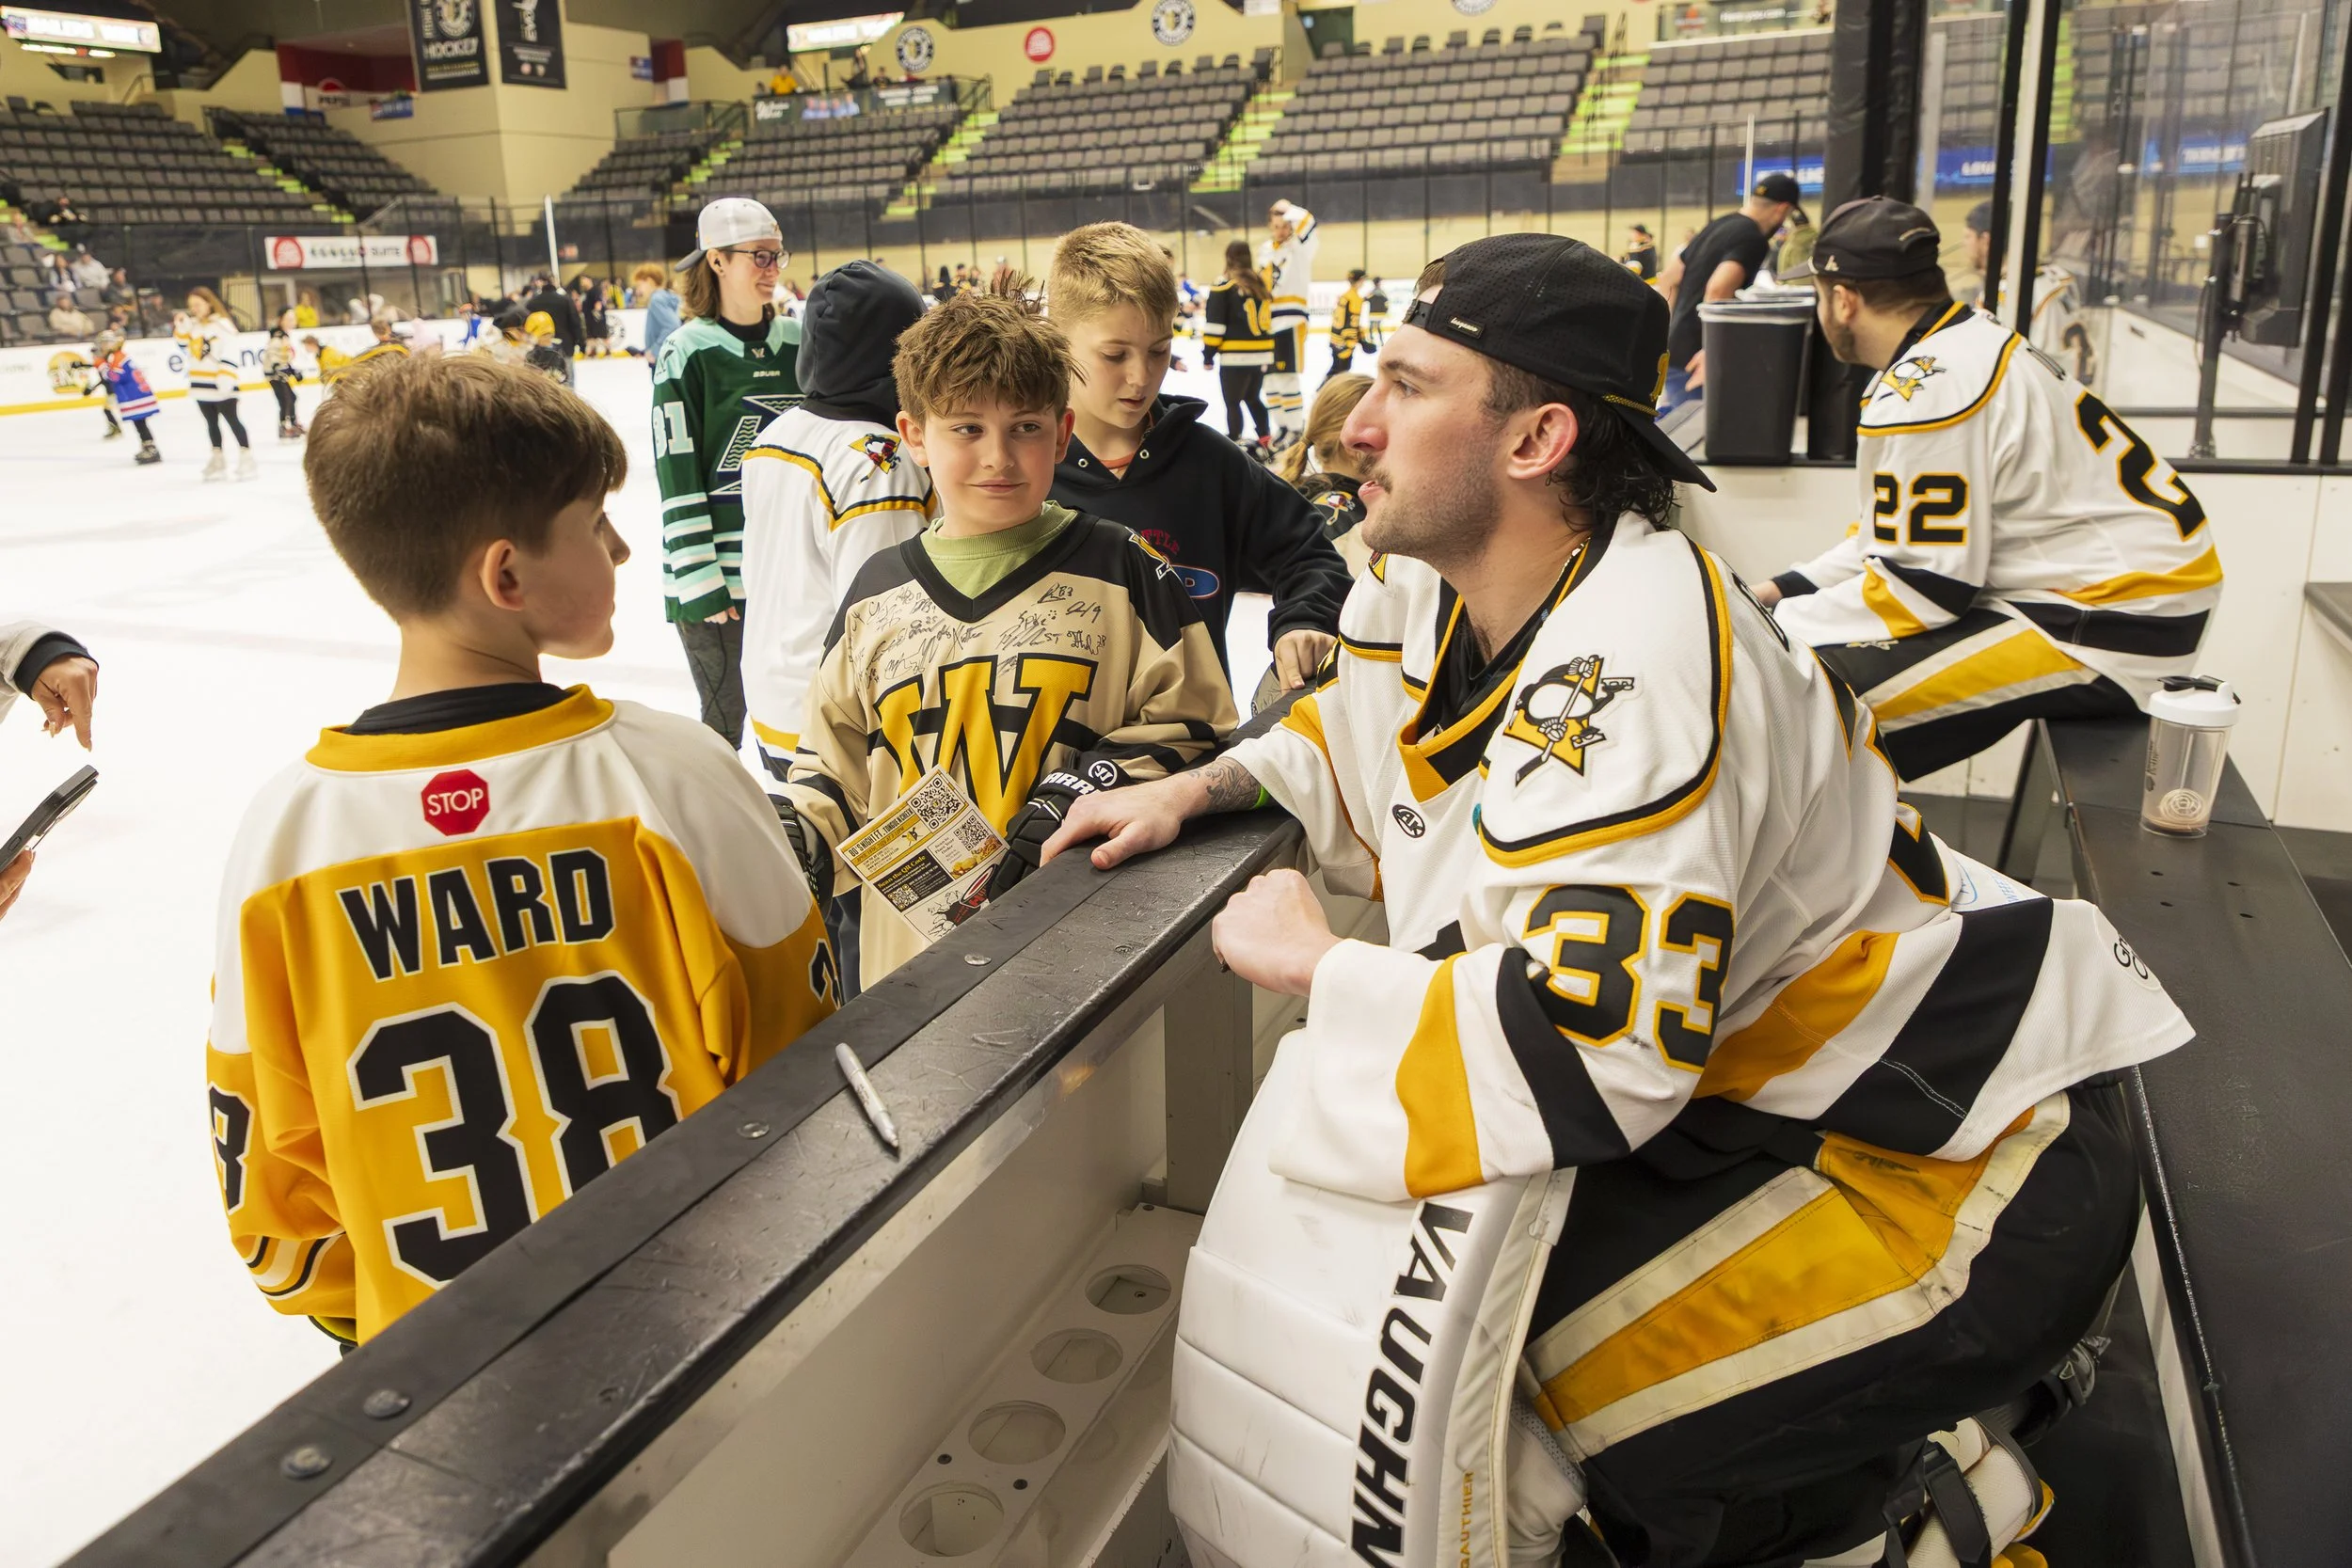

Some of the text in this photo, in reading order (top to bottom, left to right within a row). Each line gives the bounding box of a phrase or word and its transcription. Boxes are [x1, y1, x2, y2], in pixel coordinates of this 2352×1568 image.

[422, 37, 479, 59] HOCKEY
[1872, 471, 1969, 546] 22
[426, 787, 485, 816] STOP
[873, 652, 1099, 840] W
[336, 847, 616, 983] WARD
[892, 870, 901, 879] the
[900, 863, 912, 874] QR
[910, 854, 925, 866] Code
[1521, 883, 1735, 1074] 33
[346, 970, 684, 1291] 38
[1351, 1200, 1474, 1568] VAUGHN
